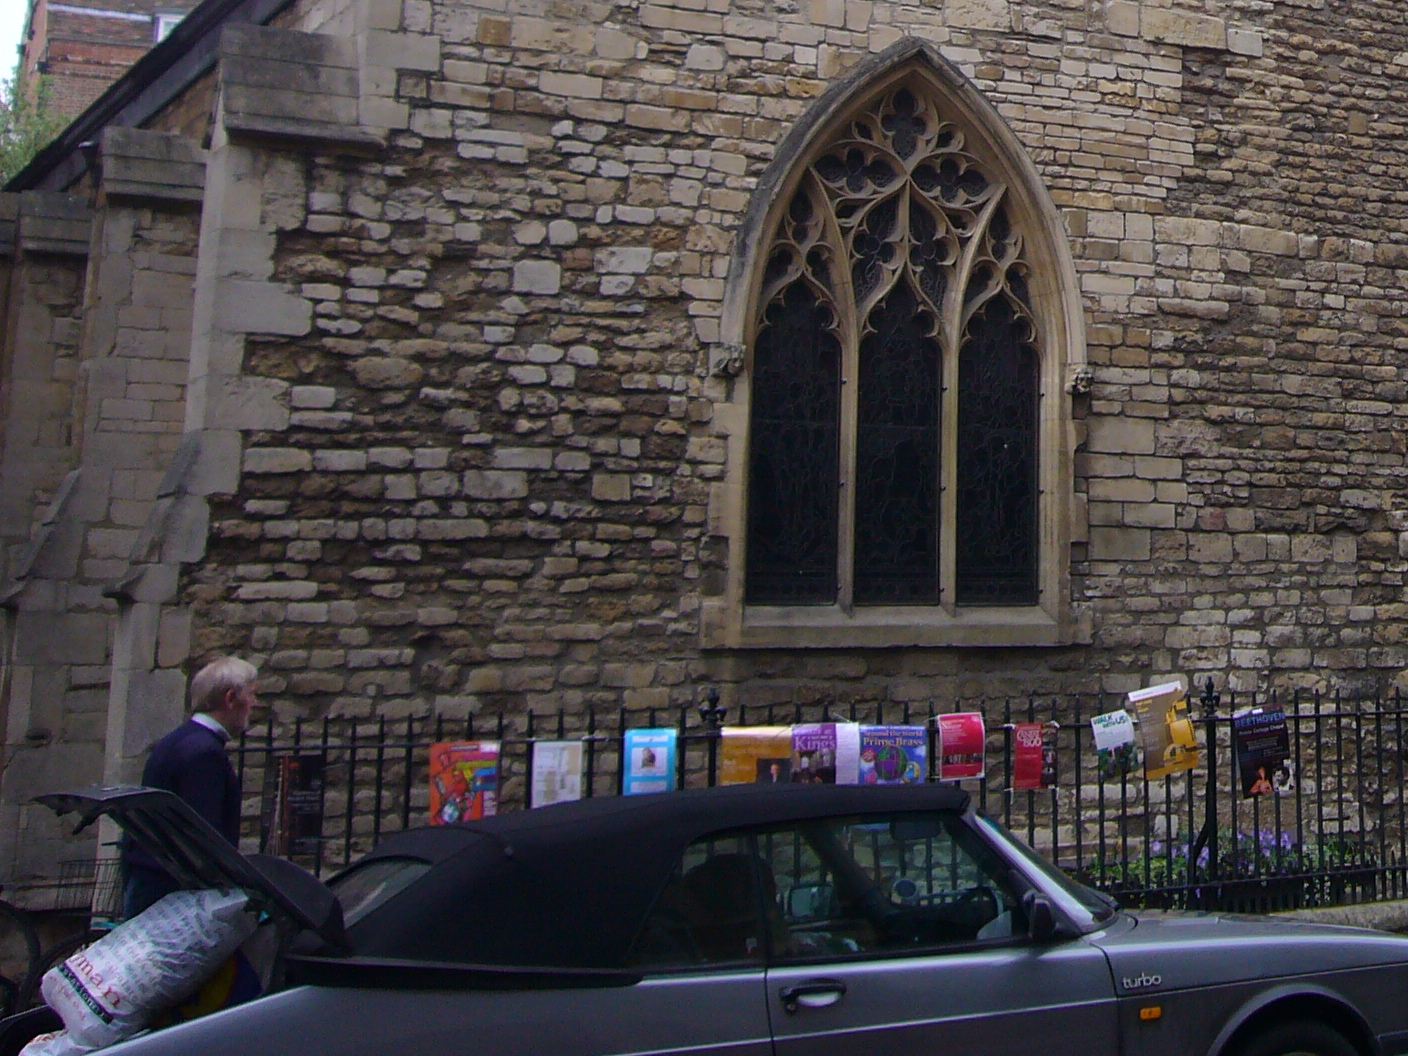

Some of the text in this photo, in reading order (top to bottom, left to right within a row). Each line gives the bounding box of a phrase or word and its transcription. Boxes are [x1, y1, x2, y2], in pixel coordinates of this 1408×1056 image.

[1235, 712, 1285, 727] BEETHOVEN
[863, 737, 923, 747] Prime Brass
[68, 954, 121, 1008] yman
[1123, 971, 1161, 989] turbo
